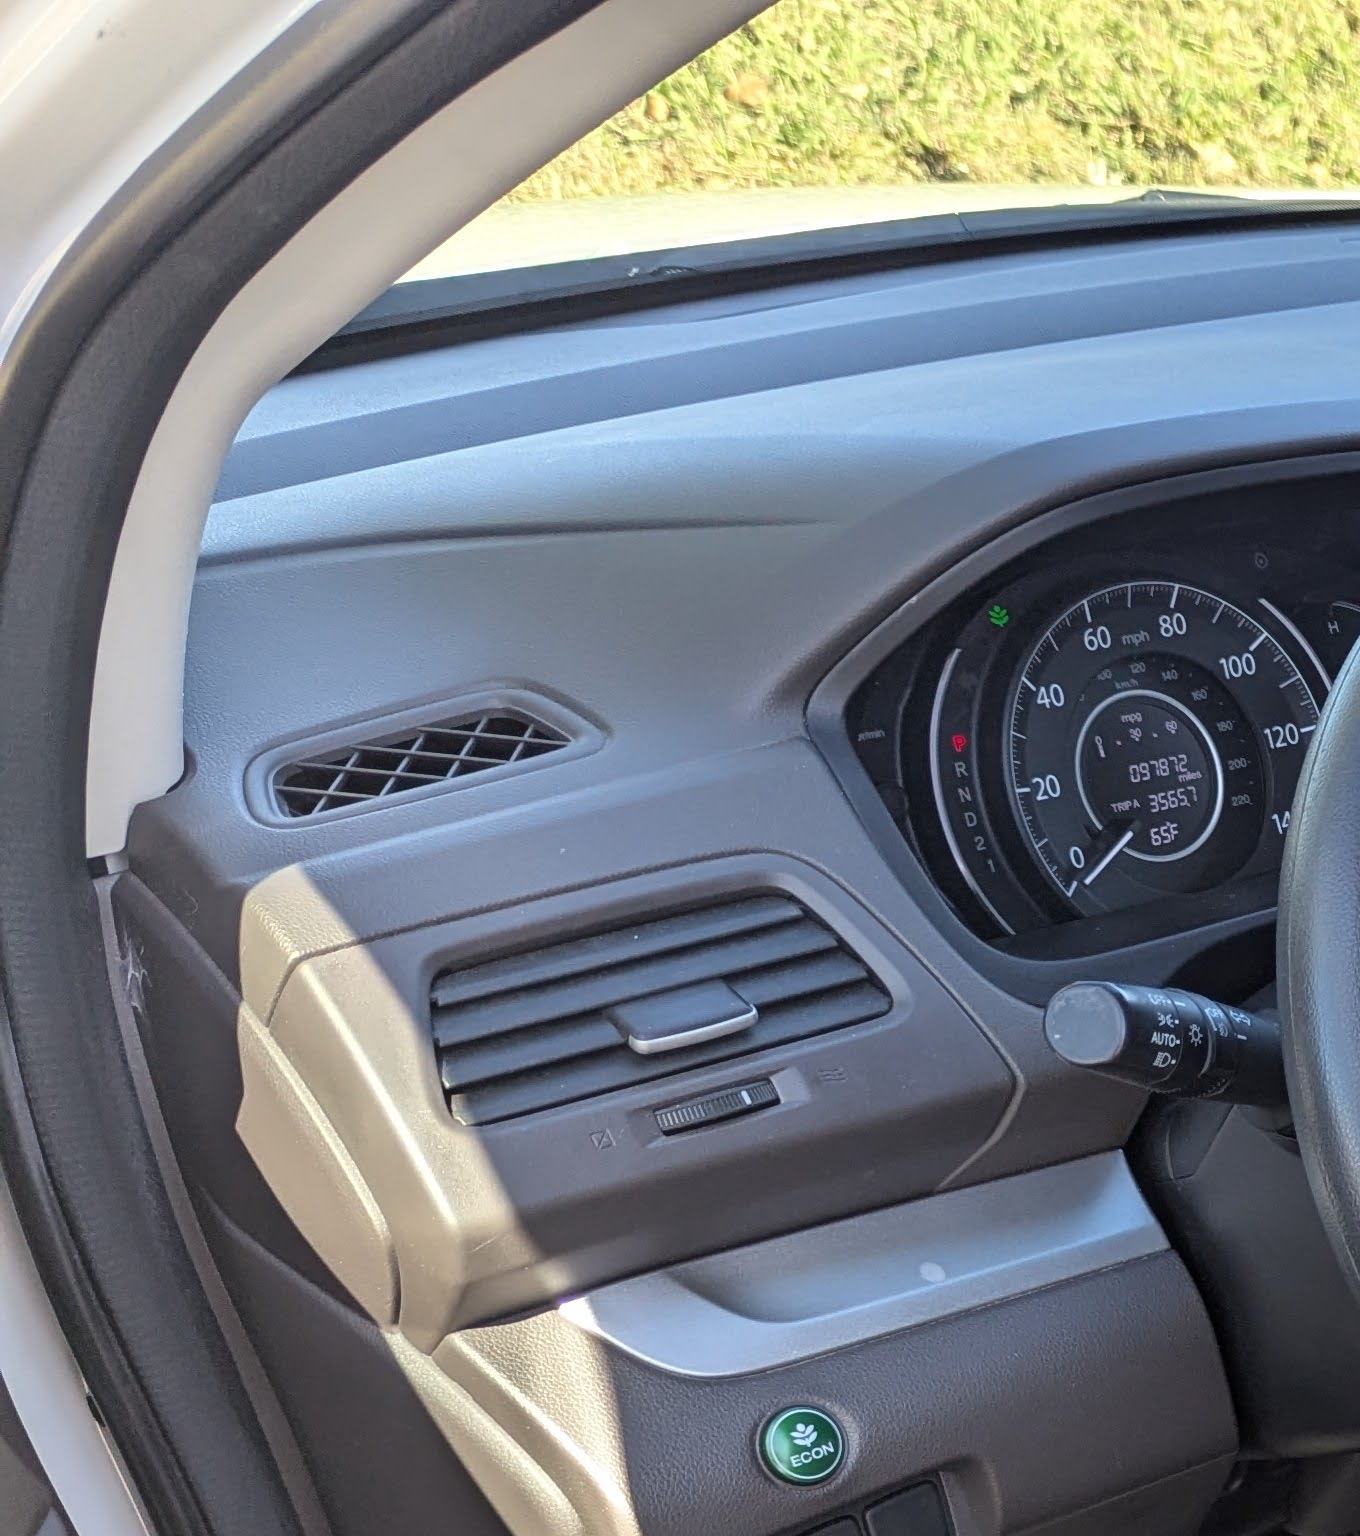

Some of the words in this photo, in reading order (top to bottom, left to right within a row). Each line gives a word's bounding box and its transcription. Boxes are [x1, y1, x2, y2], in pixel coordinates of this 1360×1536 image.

[1159, 613, 1187, 637] 80
[1328, 621, 1339, 634] H
[1084, 626, 1111, 651] 60
[1121, 630, 1150, 646] mph
[1219, 653, 1256, 679] 100
[1036, 684, 1065, 709] 40
[1121, 712, 1142, 724] mpg
[952, 734, 966, 752] P
[1264, 723, 1299, 749] 120
[954, 761, 968, 777] R
[1129, 754, 1188, 783] 097872
[1228, 758, 1247, 770] 200
[1178, 770, 1202, 782] miles
[958, 786, 972, 802] N
[1032, 774, 1061, 800] 20
[964, 812, 977, 827] D
[1272, 810, 1291, 835] 14
[974, 836, 987, 851] 2
[987, 859, 996, 872] 1
[1069, 846, 1085, 869] 0
[1151, 1032, 1176, 1047] AUTO
[790, 1441, 834, 1468] ECON
